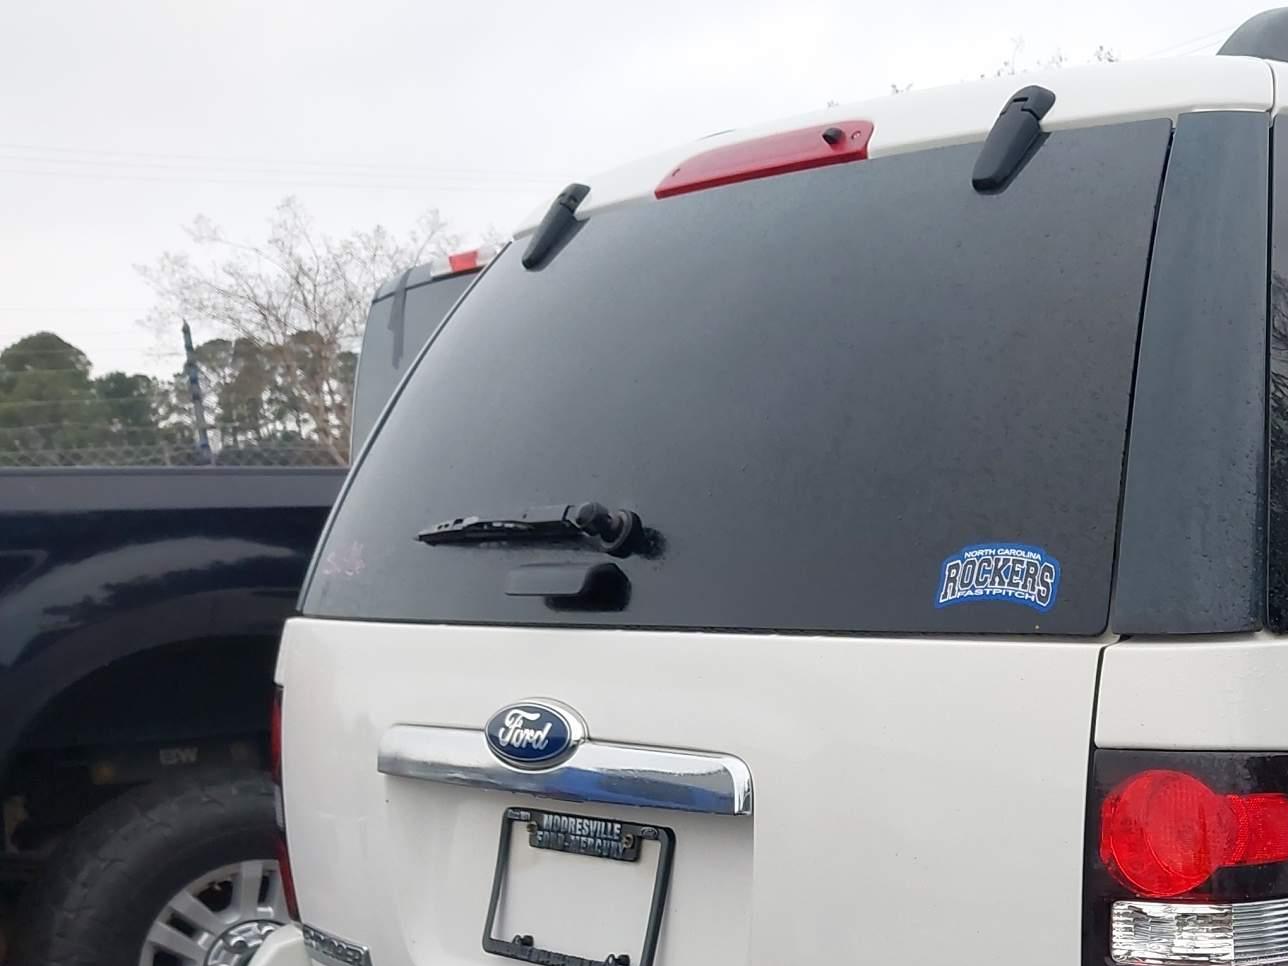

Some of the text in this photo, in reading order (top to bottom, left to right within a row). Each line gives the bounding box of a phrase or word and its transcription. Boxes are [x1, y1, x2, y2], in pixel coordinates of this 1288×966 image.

[964, 548, 1041, 560] NORTH CAROLINA
[939, 556, 1055, 607] ROCKERS
[957, 588, 1035, 602] FASTPITCH
[498, 709, 552, 750] Ford
